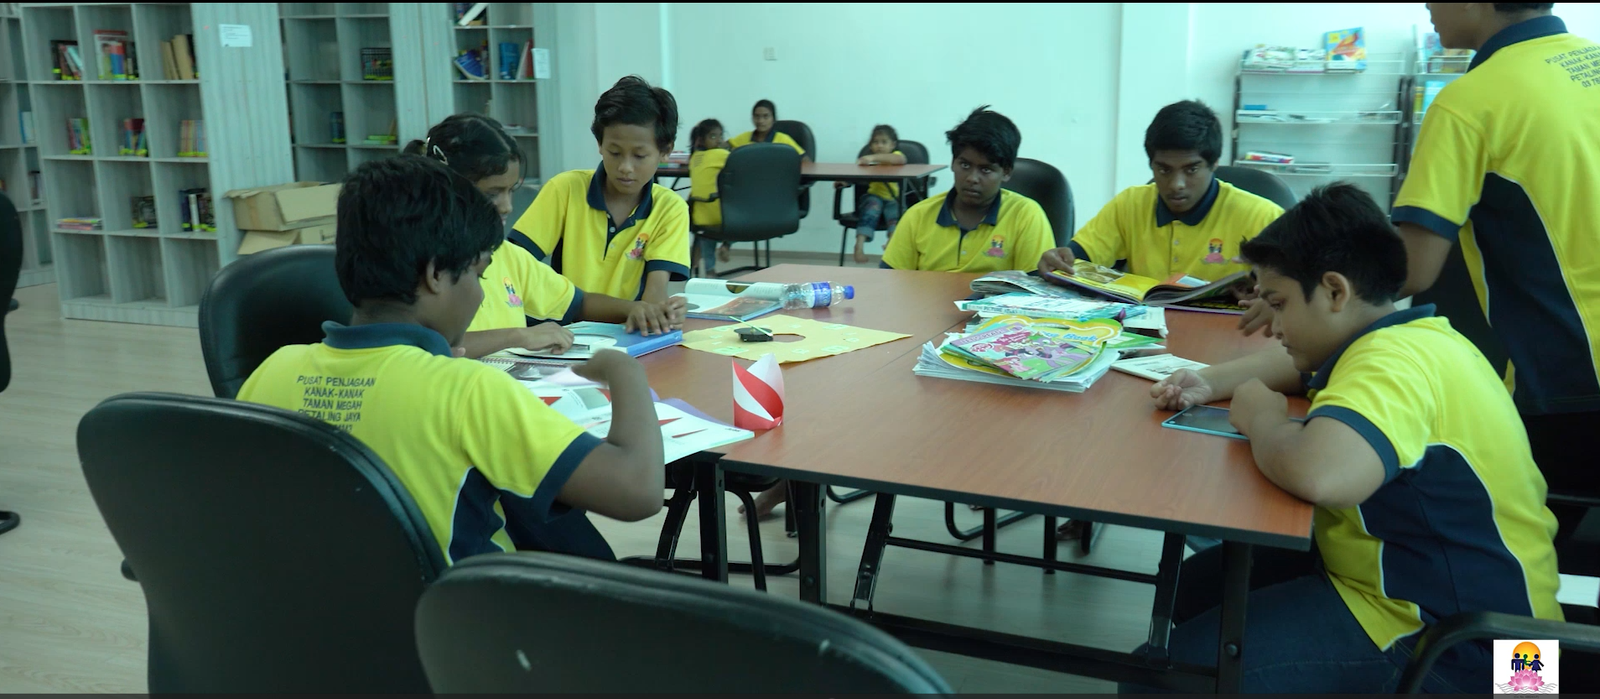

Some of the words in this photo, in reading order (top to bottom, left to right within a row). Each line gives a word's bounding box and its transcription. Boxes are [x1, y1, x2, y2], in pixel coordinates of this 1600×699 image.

[1566, 63, 1590, 73] TAMAN
[297, 375, 322, 386] PUSAT
[326, 377, 376, 387] PENJAGAAN
[304, 387, 365, 398] KANAK-KANAK
[303, 398, 333, 410] TAMAN
[336, 401, 362, 411] MEGAH
[344, 412, 361, 422] JAYA
